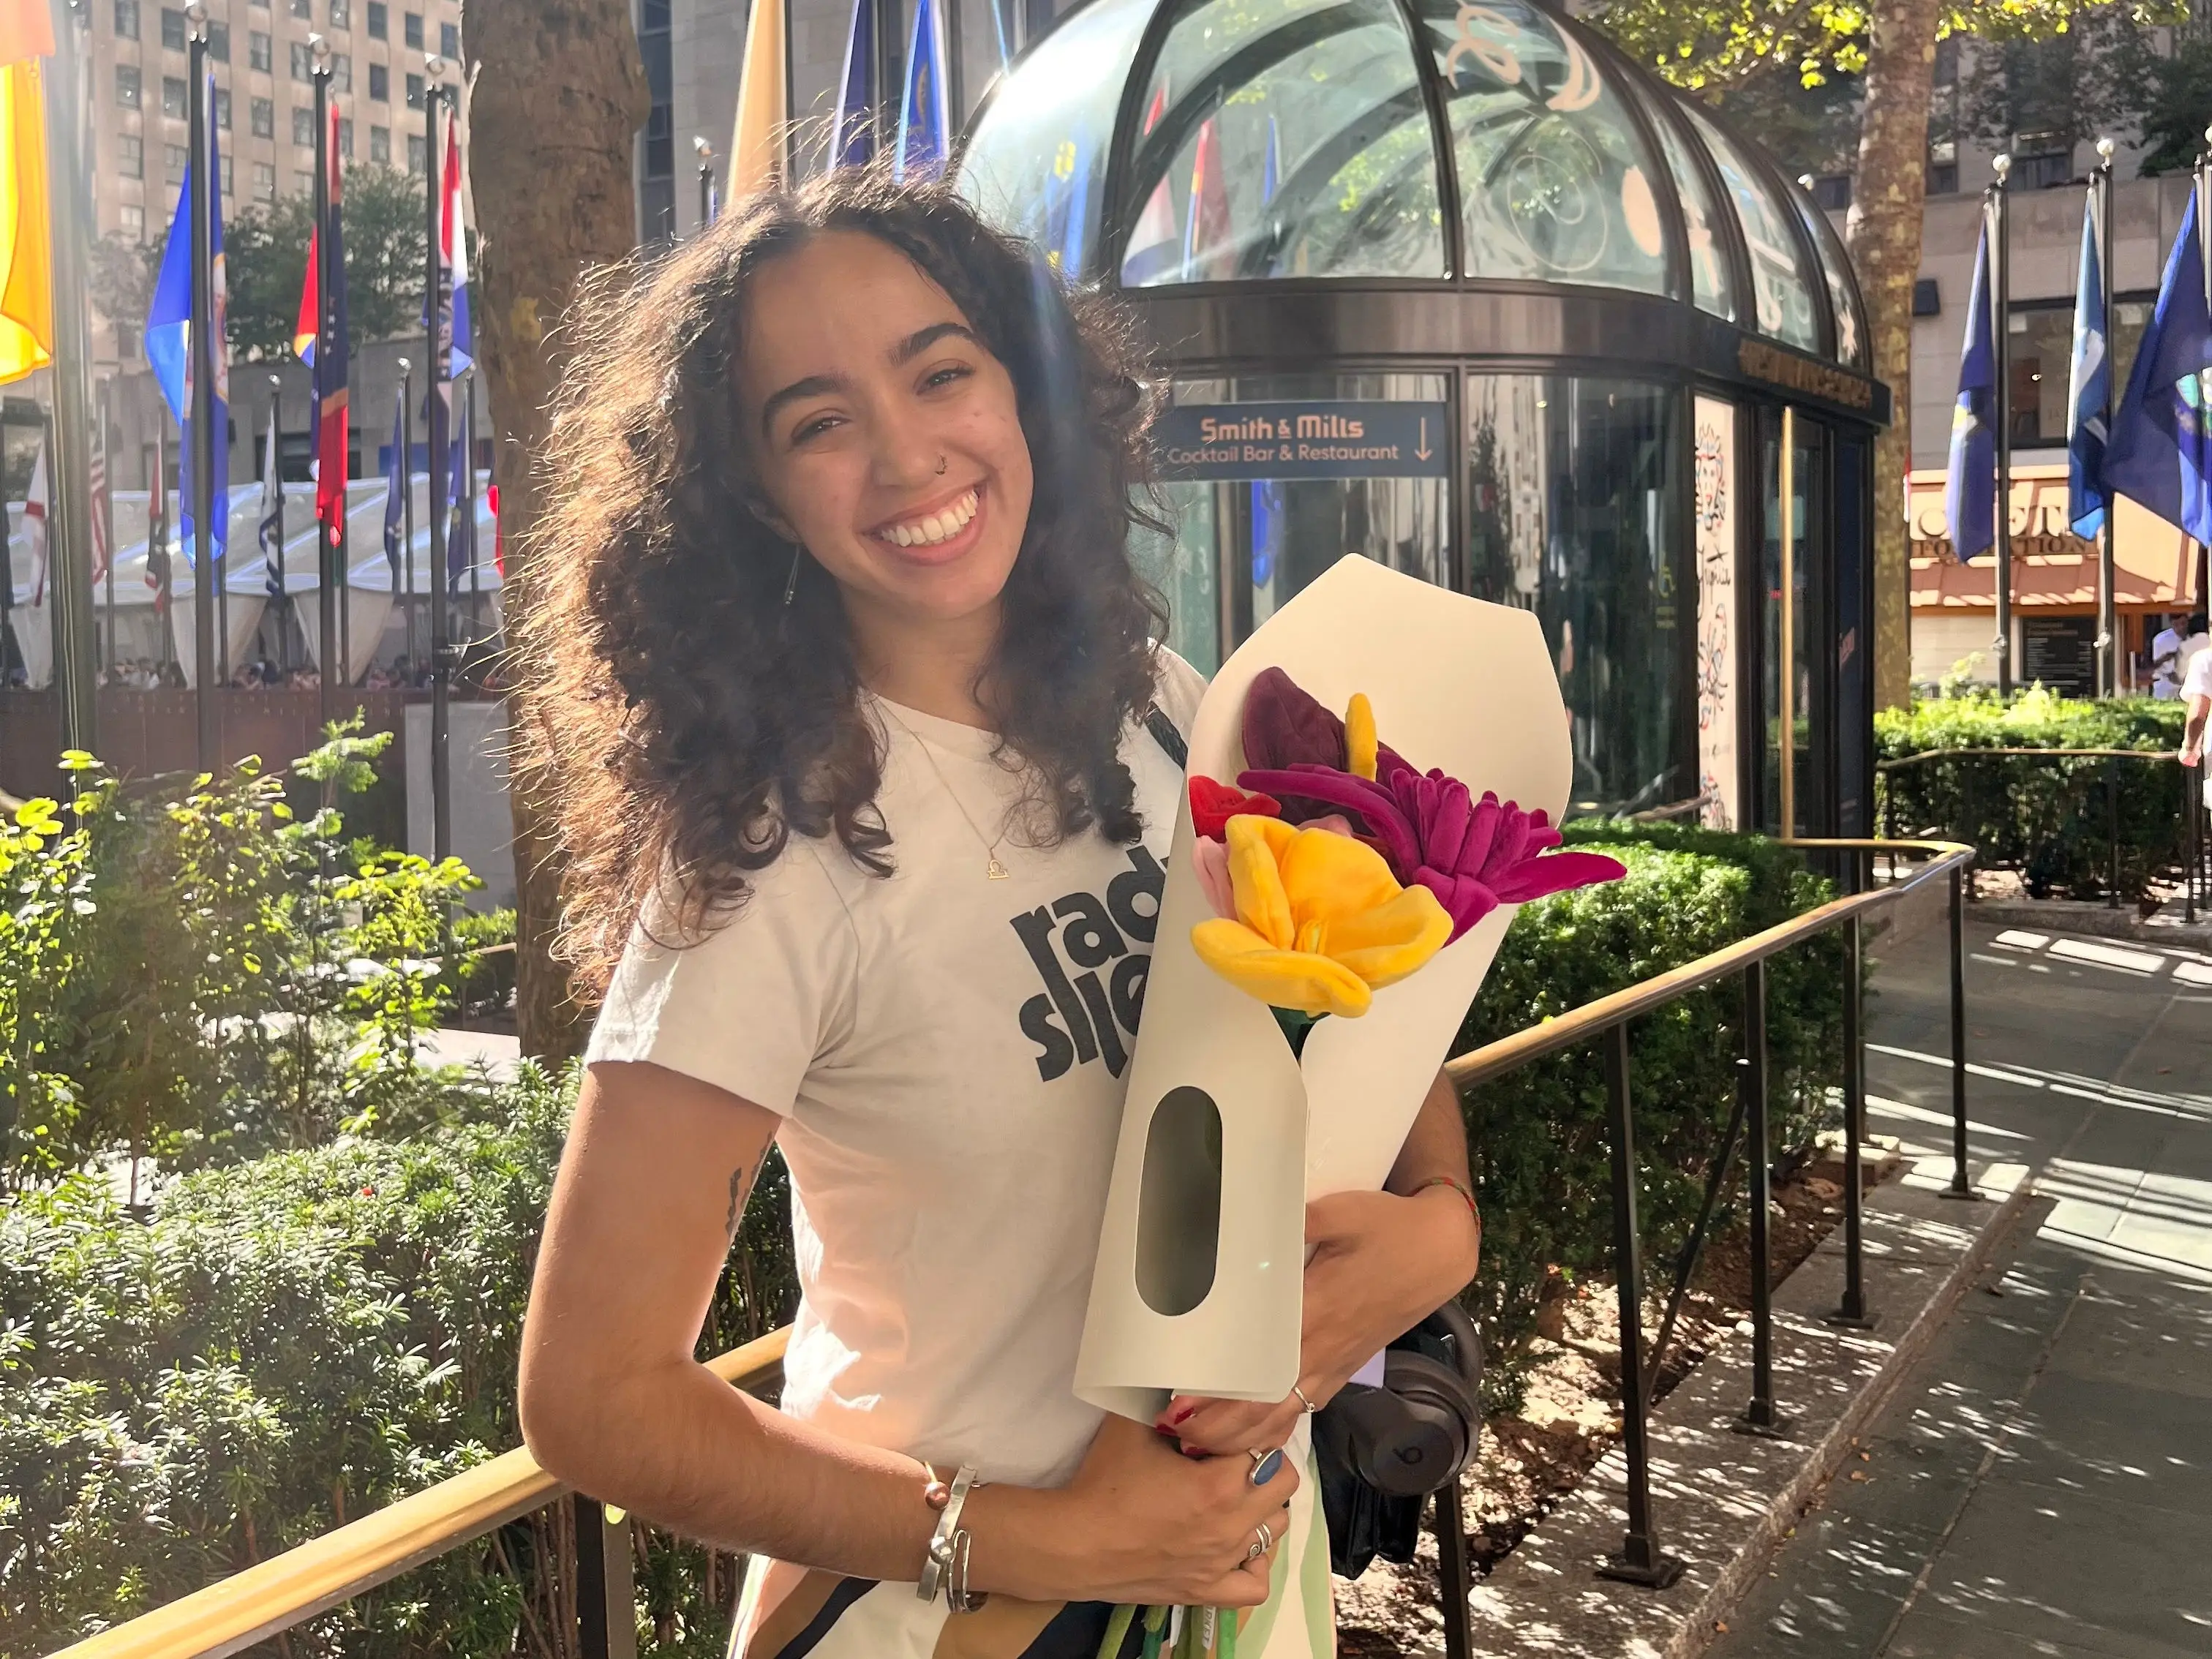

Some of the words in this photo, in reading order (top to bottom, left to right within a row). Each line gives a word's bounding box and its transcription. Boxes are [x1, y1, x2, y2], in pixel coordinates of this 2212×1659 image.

[1200, 415, 1273, 441] Smith
[1278, 418, 1293, 439] &
[1297, 415, 1365, 439] Mills
[1170, 445, 1238, 464] Cocktail
[1244, 445, 1275, 462] Bar
[1279, 444, 1293, 462] &
[1298, 444, 1399, 461] Restaurant
[1009, 845, 1170, 969] rad
